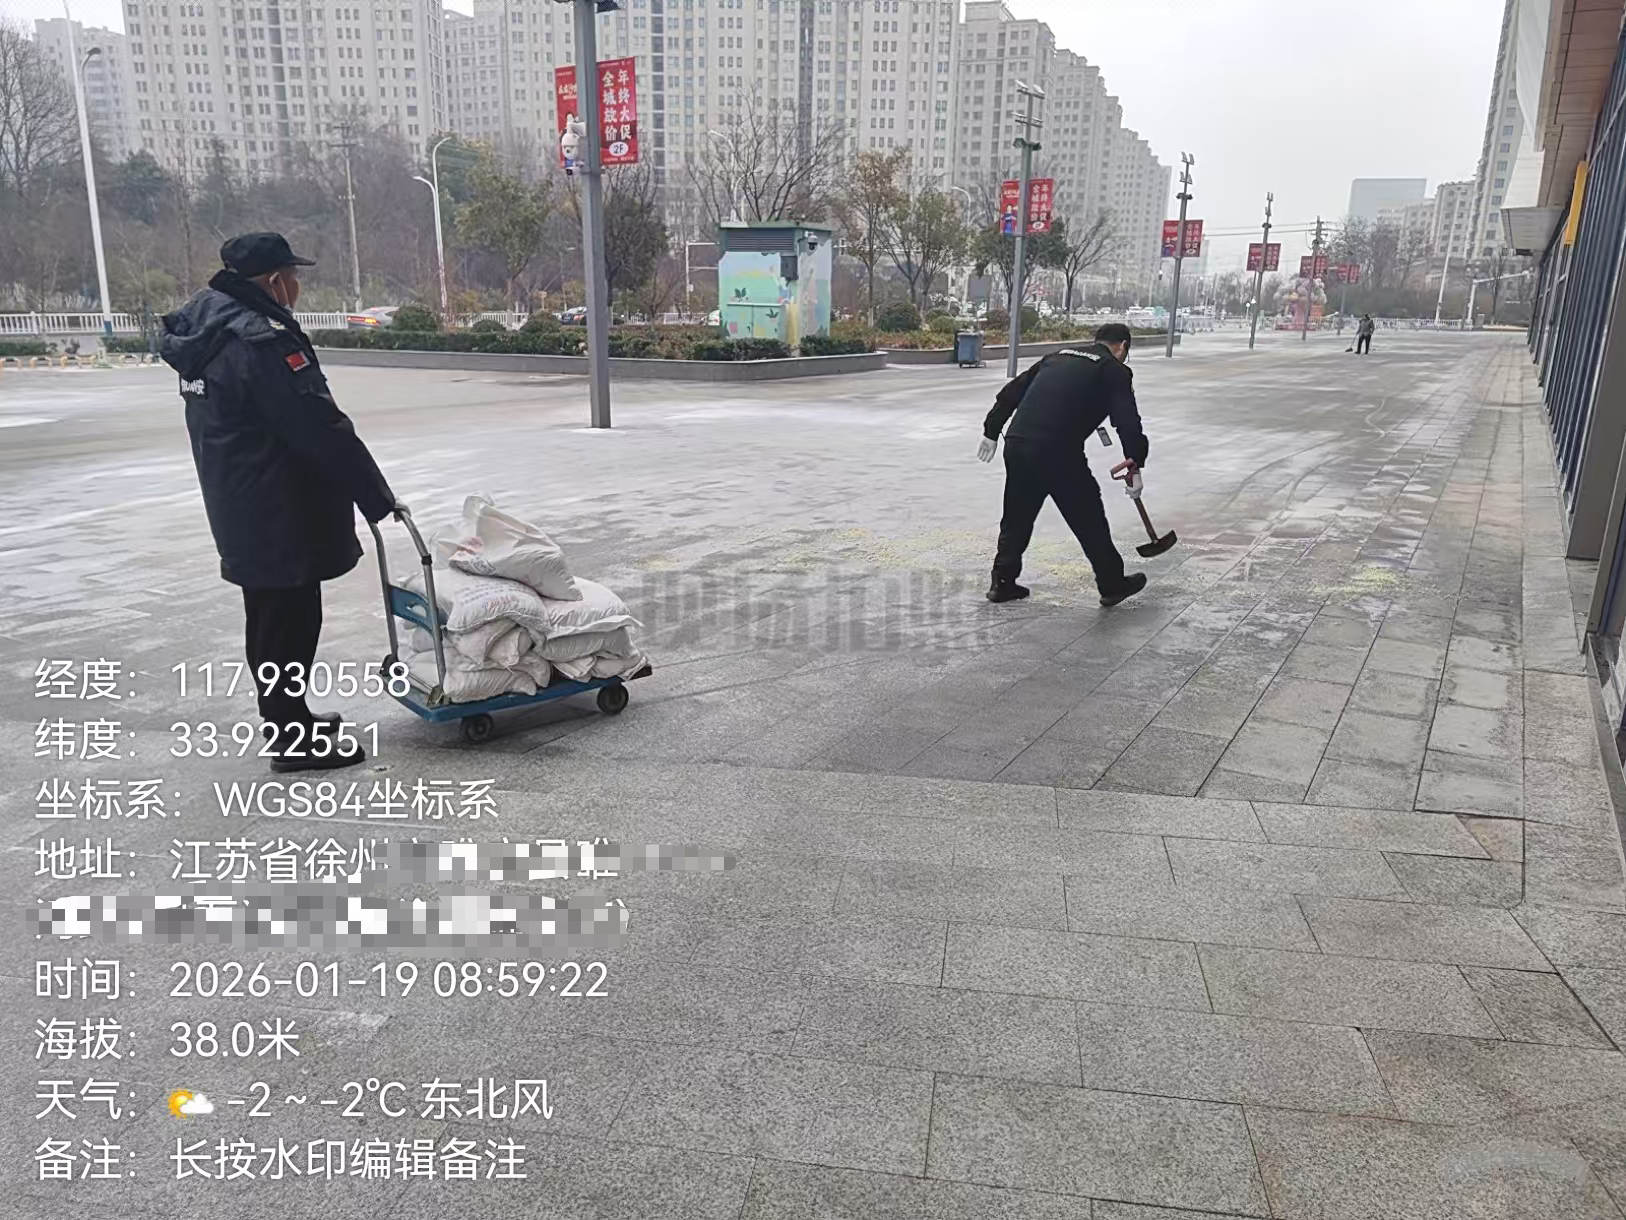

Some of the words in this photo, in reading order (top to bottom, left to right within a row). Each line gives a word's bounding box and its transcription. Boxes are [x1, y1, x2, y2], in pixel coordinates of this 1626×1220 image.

[602, 70, 617, 140] 全城放价
[618, 69, 632, 140] 年终大促
